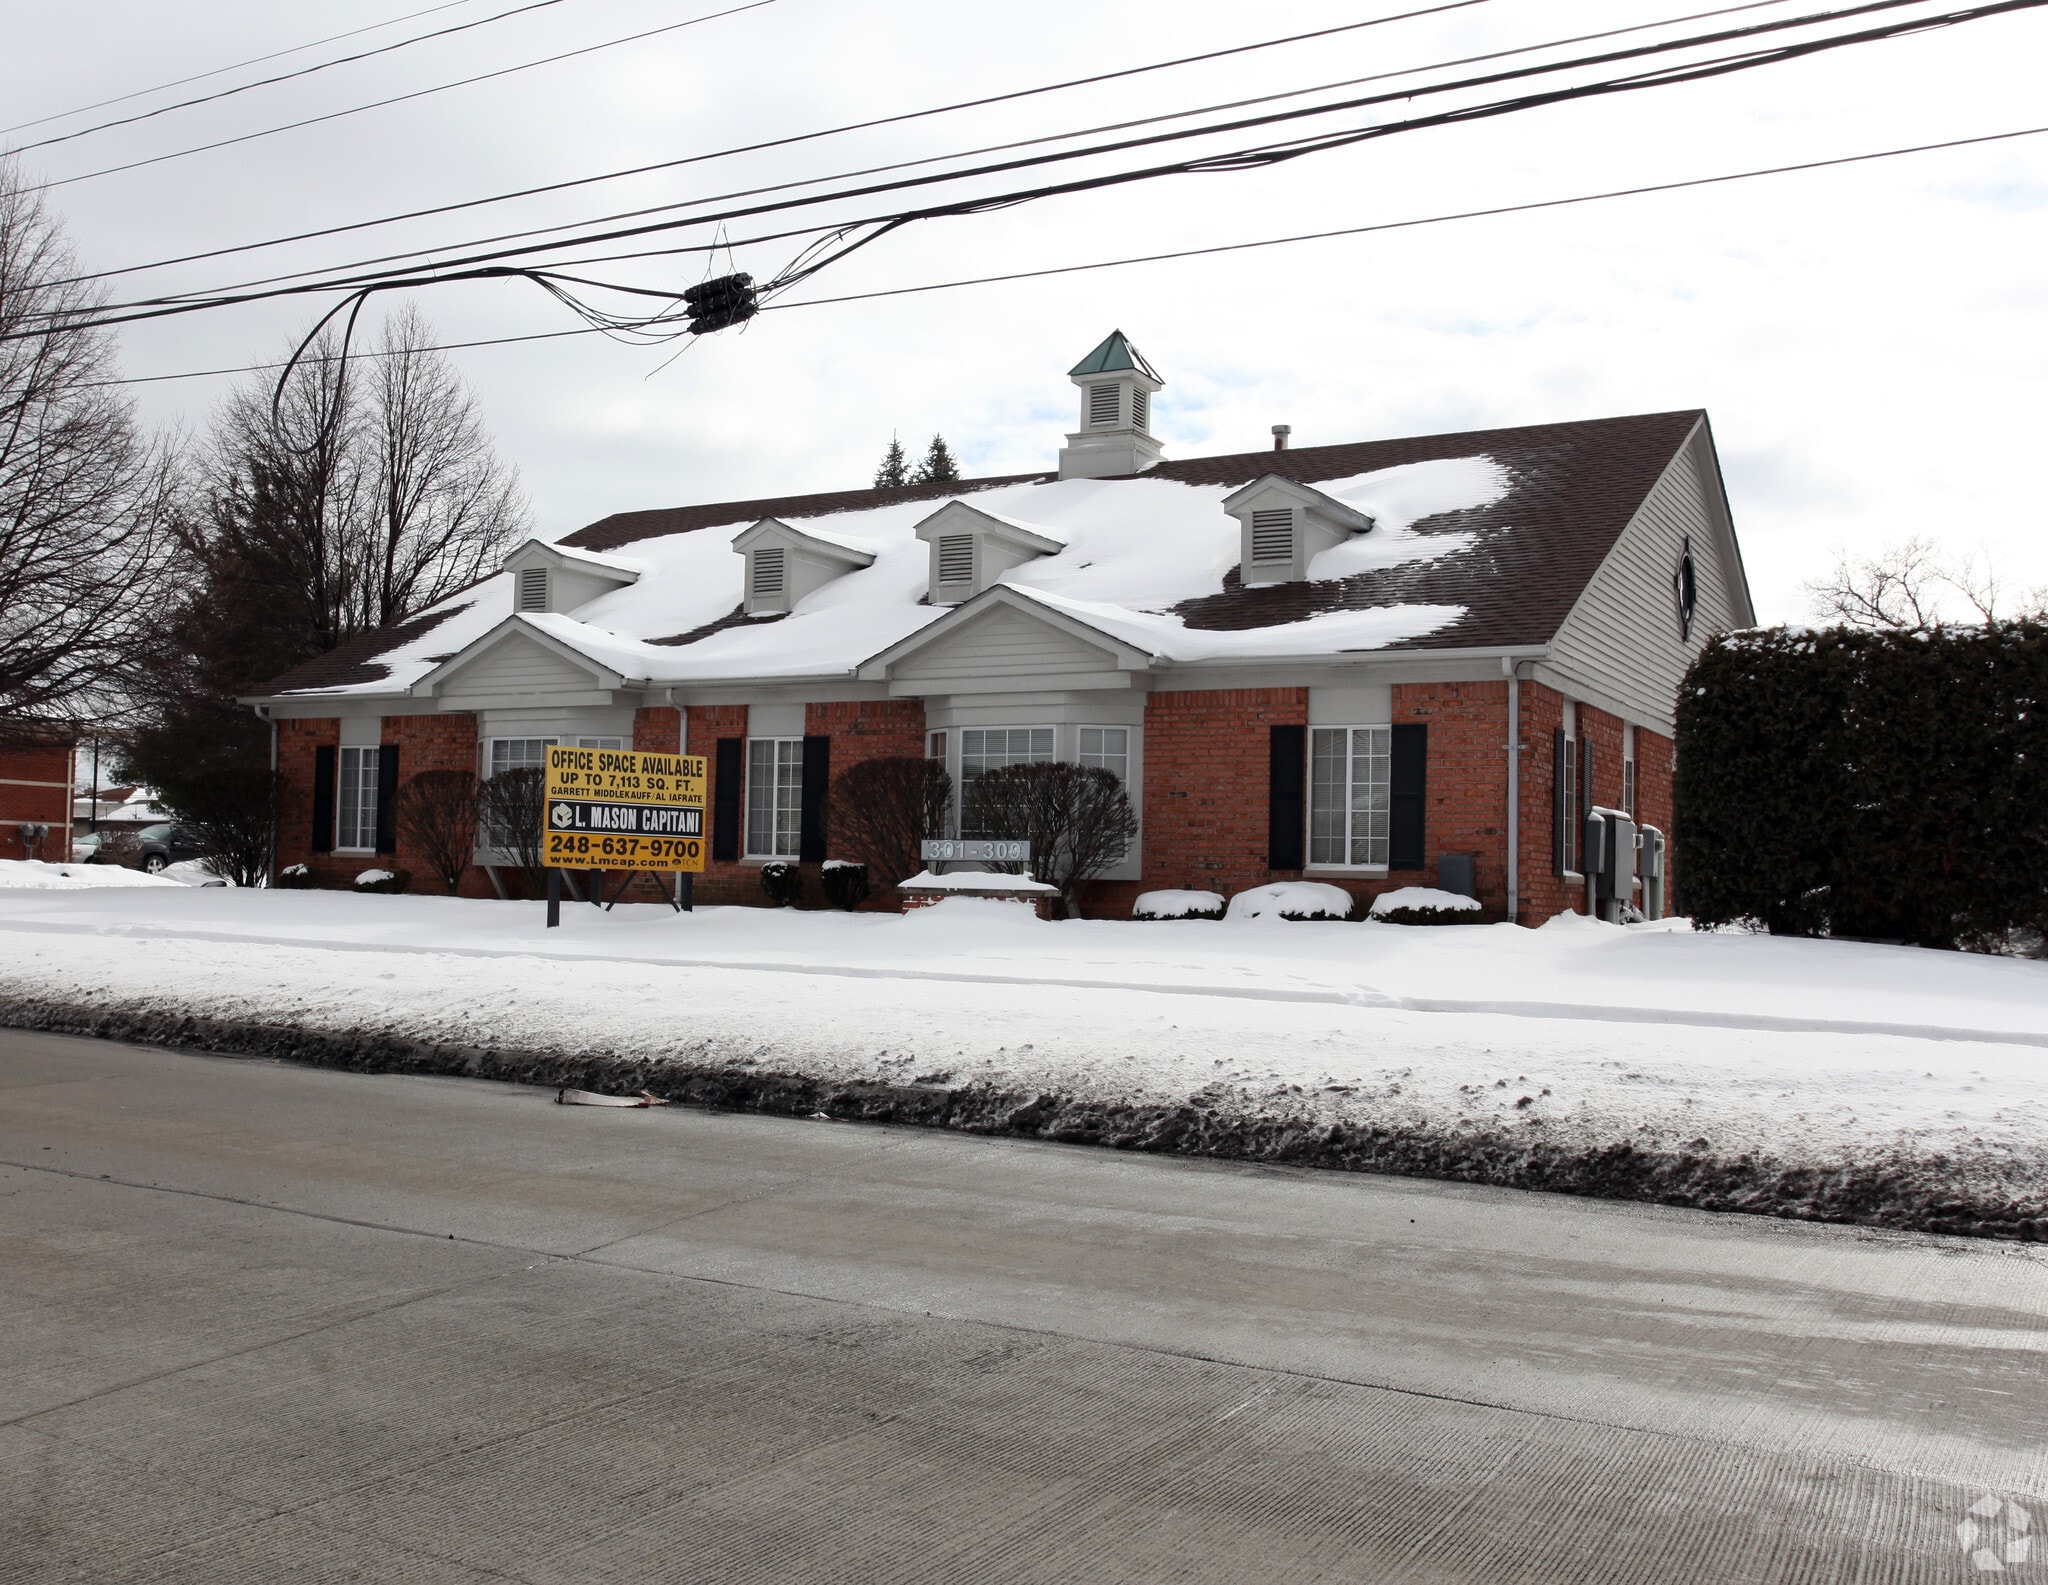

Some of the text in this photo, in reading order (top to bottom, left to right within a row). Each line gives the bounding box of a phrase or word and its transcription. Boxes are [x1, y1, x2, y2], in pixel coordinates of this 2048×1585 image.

[552, 750, 702, 777] OFFICE SPACE AVAILABLE
[561, 772, 694, 791] UP TO 7,113 SQ. FT.
[551, 786, 590, 796] GARRETT
[669, 793, 702, 803] IAFRATE
[575, 806, 699, 833] L. MASON CAPITANI
[550, 835, 700, 858] 248-637-9700
[550, 856, 668, 867] www.Lmcap.com
